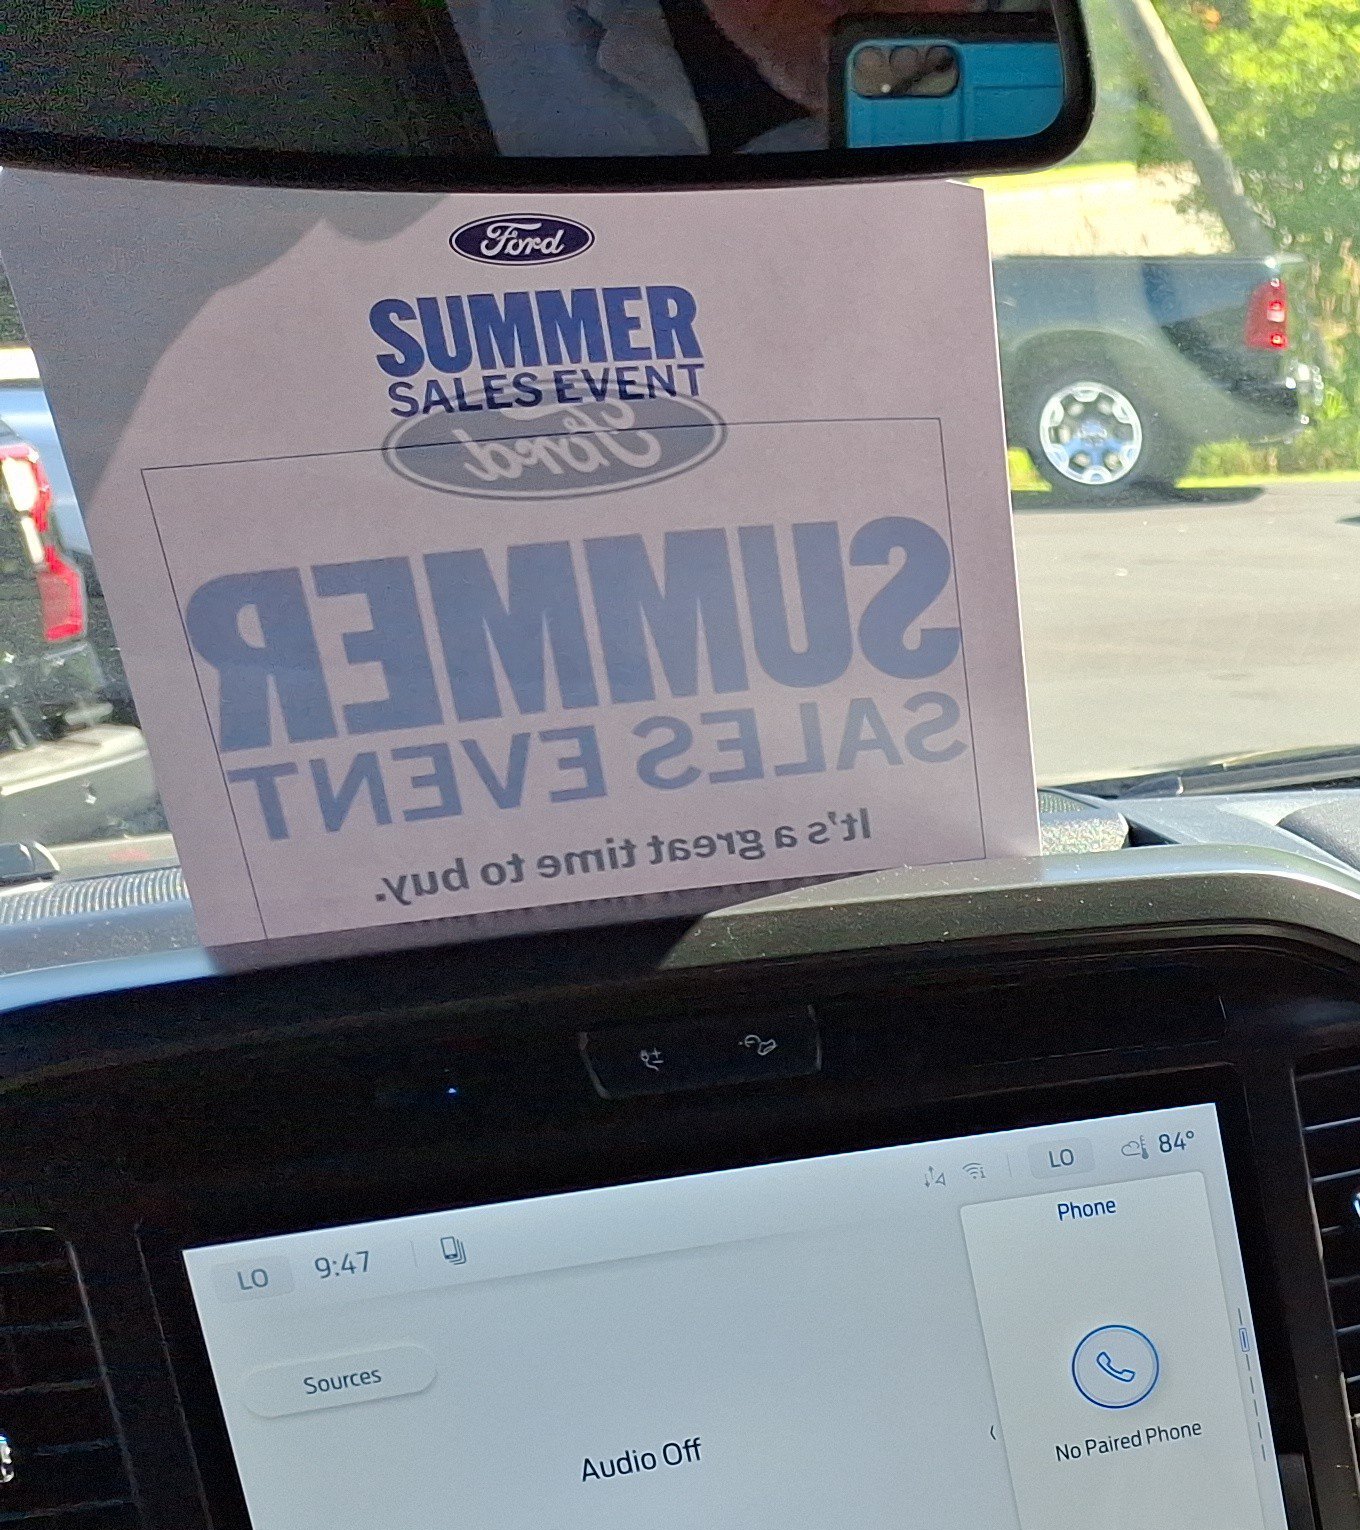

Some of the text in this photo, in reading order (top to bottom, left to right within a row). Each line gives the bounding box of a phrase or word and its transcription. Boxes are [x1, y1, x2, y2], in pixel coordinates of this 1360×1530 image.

[480, 222, 566, 256] Ford
[369, 285, 704, 378] SUMMER
[387, 363, 705, 417] SALES EVENT
[1049, 1149, 1075, 1168] LO
[1057, 1199, 1117, 1221] Phone
[236, 1250, 371, 1291] LO 9:47
[303, 1366, 382, 1395] Sources
[580, 1437, 703, 1483] Audio Off
[1055, 1421, 1203, 1462] No Paired Phone
